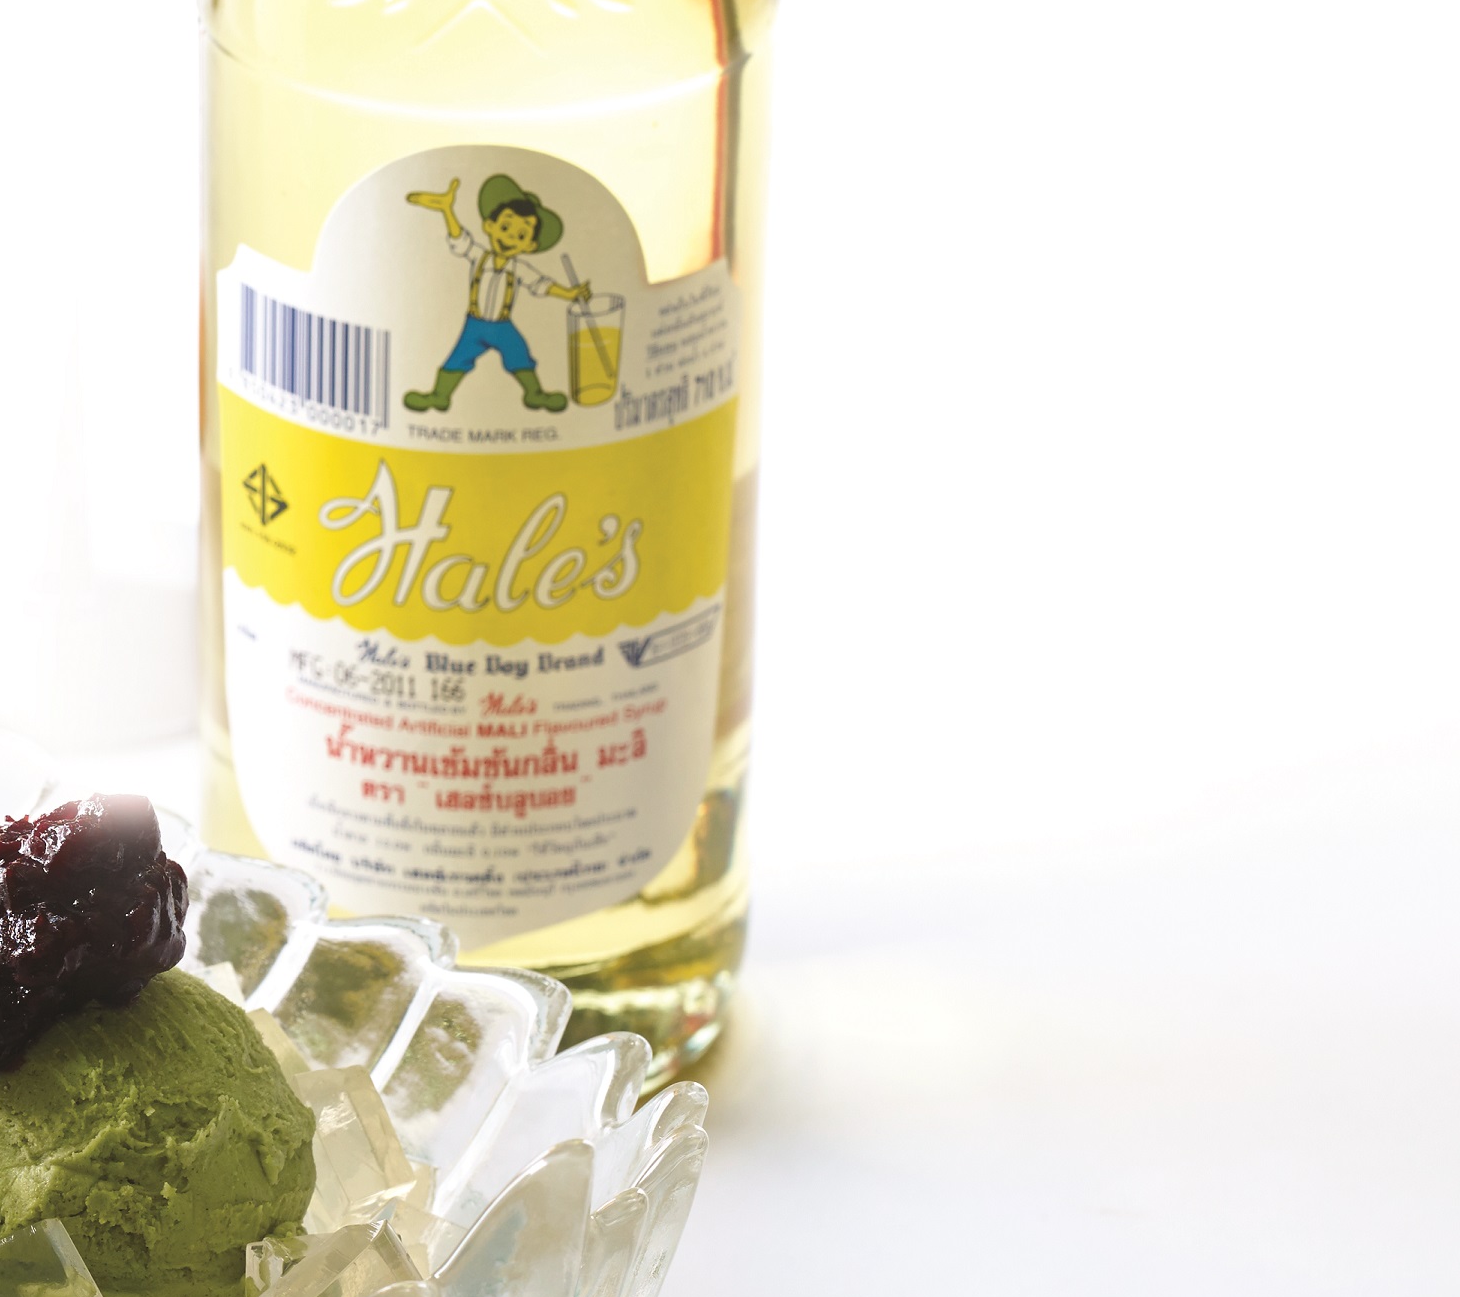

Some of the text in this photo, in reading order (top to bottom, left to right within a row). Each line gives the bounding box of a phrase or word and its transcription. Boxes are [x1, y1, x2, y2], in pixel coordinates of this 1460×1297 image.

[408, 424, 463, 442] TRADE
[468, 428, 516, 443] MARK
[318, 458, 644, 614] Hale's
[425, 653, 477, 676] Blue
[484, 655, 530, 679] Boy
[538, 645, 605, 672] Brand
[476, 722, 528, 739] MALI
